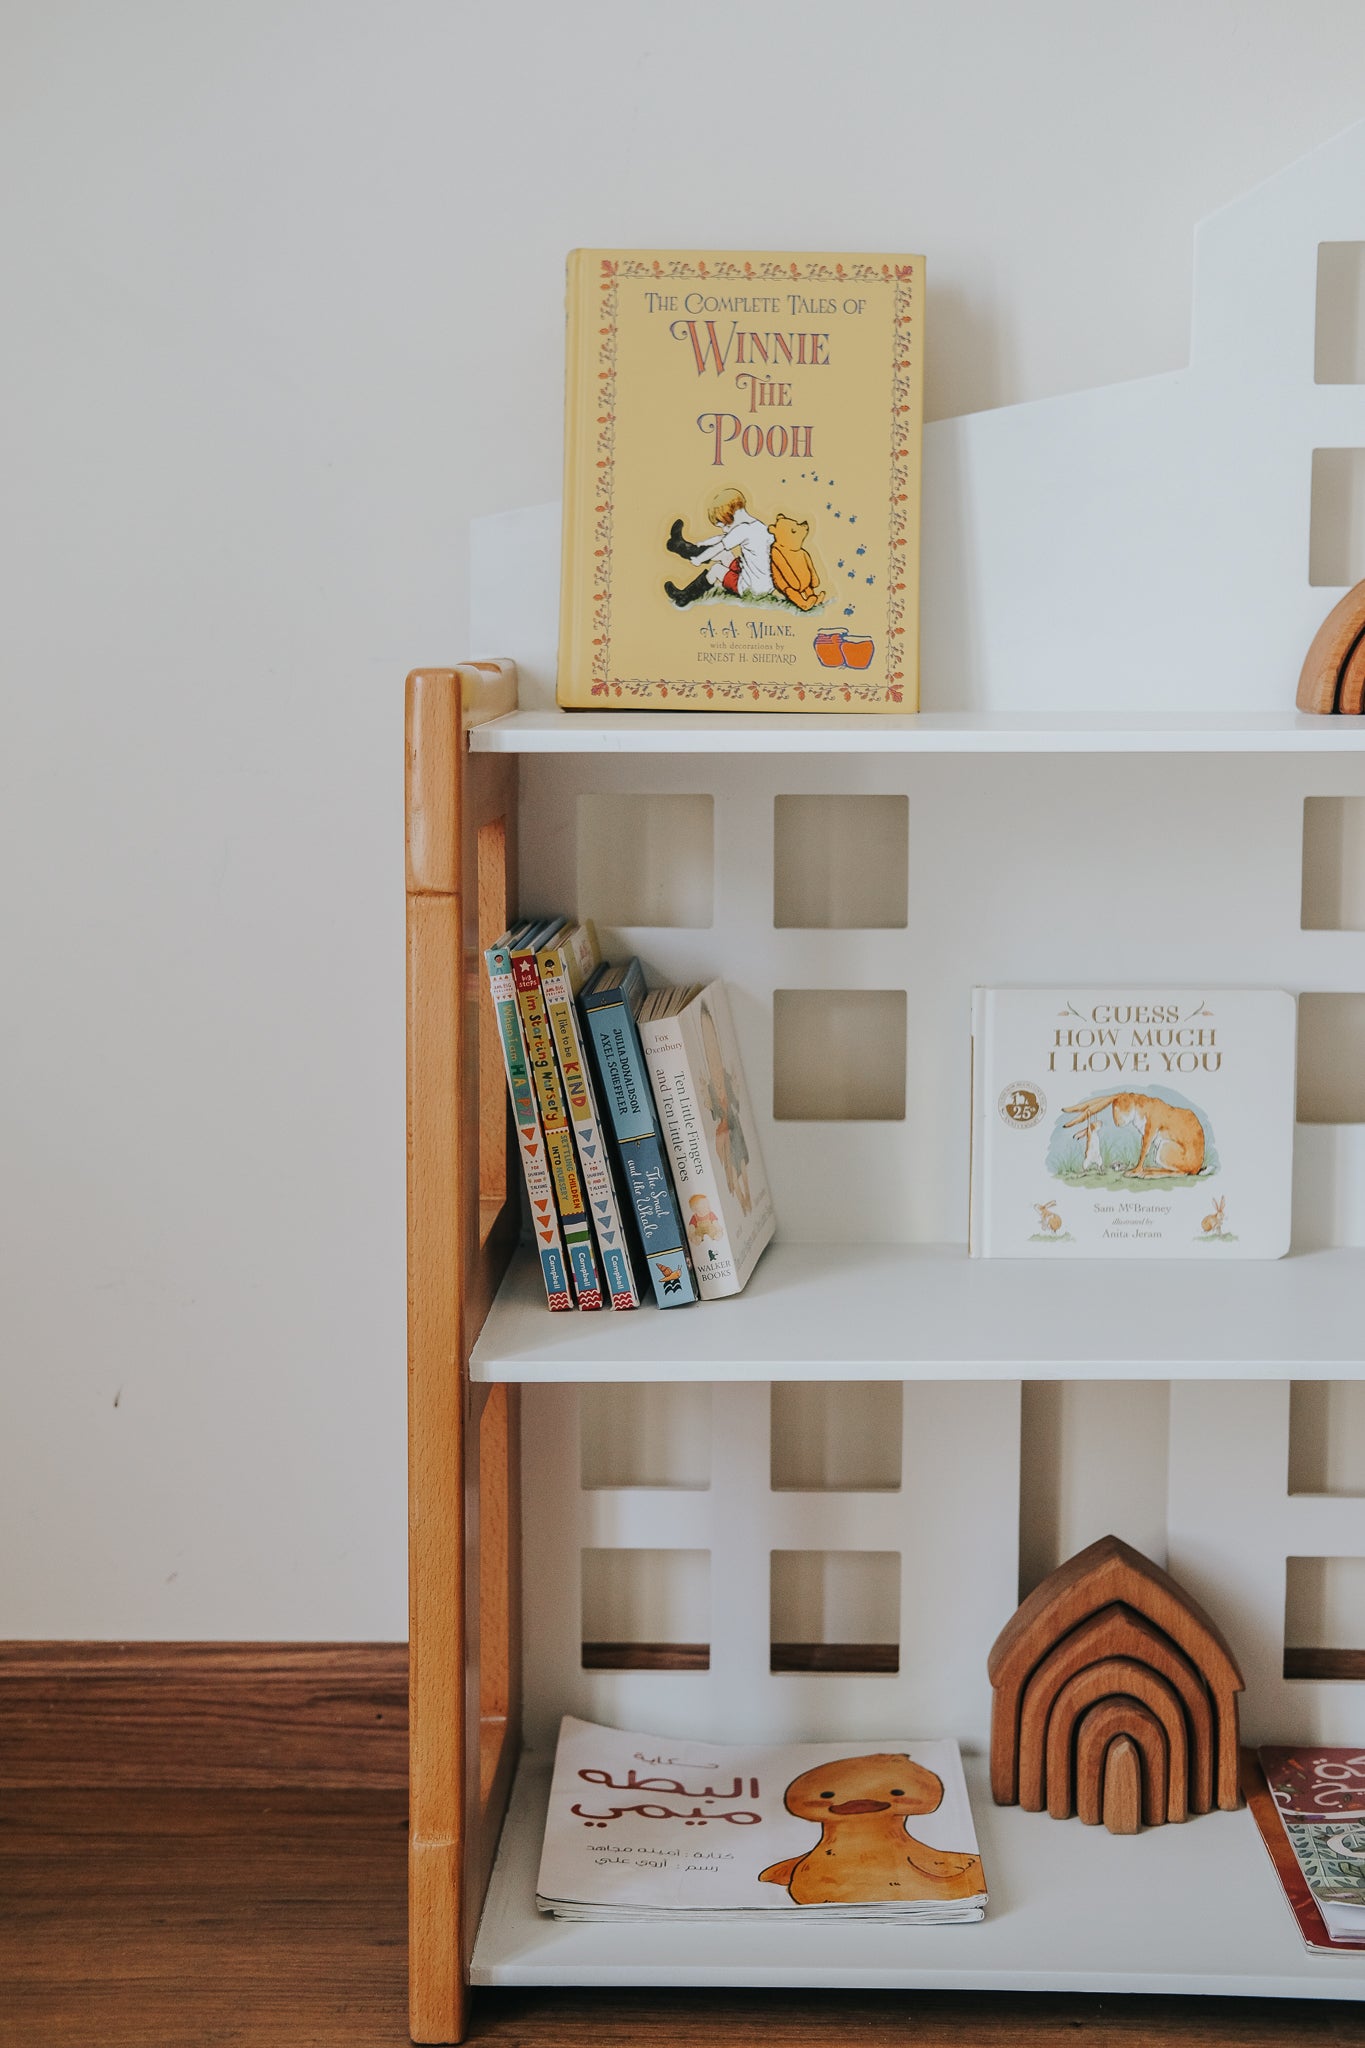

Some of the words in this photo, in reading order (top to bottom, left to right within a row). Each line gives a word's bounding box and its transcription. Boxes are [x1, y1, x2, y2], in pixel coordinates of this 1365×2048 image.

[684, 293, 780, 314] COMPLETE
[787, 294, 837, 316] TALES
[669, 320, 831, 377] WINNIE
[736, 372, 793, 413] THE
[697, 413, 815, 466] POOH
[710, 641, 727, 650] with
[730, 641, 773, 650] decorations
[776, 642, 785, 651] by
[697, 652, 736, 664] ERNEST
[753, 653, 797, 666] SHEPARD
[503, 1005, 514, 1036] When
[558, 1019, 568, 1034] like
[1092, 1005, 1180, 1024] GUESS
[562, 1036, 569, 1046] to
[613, 1028, 625, 1057] JULIA
[645, 1041, 684, 1056] Oxenbury
[654, 1034, 669, 1044] Fox
[1053, 1028, 1121, 1047] HOW
[1131, 1028, 1217, 1047] MUCH
[509, 1045, 517, 1061] am
[564, 1047, 572, 1058] be
[1047, 1051, 1057, 1073] I
[1070, 1051, 1150, 1073] LOVE
[1161, 1051, 1224, 1073] YOU
[529, 1014, 549, 1068] Starting
[542, 1071, 559, 1122] Nursery
[600, 1032, 613, 1061] AXEL
[608, 1060, 629, 1114] SCHEFFLER
[511, 1064, 533, 1117] HAPPY
[563, 1061, 586, 1107] KIND
[618, 1056, 641, 1114] DONALDSON
[674, 1070, 685, 1094] Ten
[656, 1068, 667, 1092] and
[662, 1093, 674, 1117] Ten
[668, 1116, 682, 1151] Little
[675, 1151, 689, 1182] Toes
[679, 1094, 694, 1134] Little
[552, 1145, 561, 1166] INTO
[686, 1133, 704, 1176] Fingers
[560, 1135, 574, 1172] SETTLING
[568, 1173, 581, 1209] CHILDREN
[627, 1159, 637, 1178] and
[645, 1166, 663, 1191] The
[633, 1178, 645, 1197] the
[652, 1188, 670, 1218] Snail
[1093, 1203, 1115, 1213] Sam
[1118, 1203, 1172, 1215] McBratney
[637, 1196, 653, 1239] Whale
[1102, 1228, 1129, 1238] Anita
[1131, 1228, 1162, 1238] Jeram
[549, 1254, 561, 1289] Campbell
[578, 1252, 591, 1287] Campbell
[611, 1255, 625, 1289] Campbell
[697, 1259, 732, 1274] WALKER
[701, 1269, 732, 1282] BOOKS
[570, 1804, 763, 1828] ميمي
[684, 1865, 719, 1873] رسم
